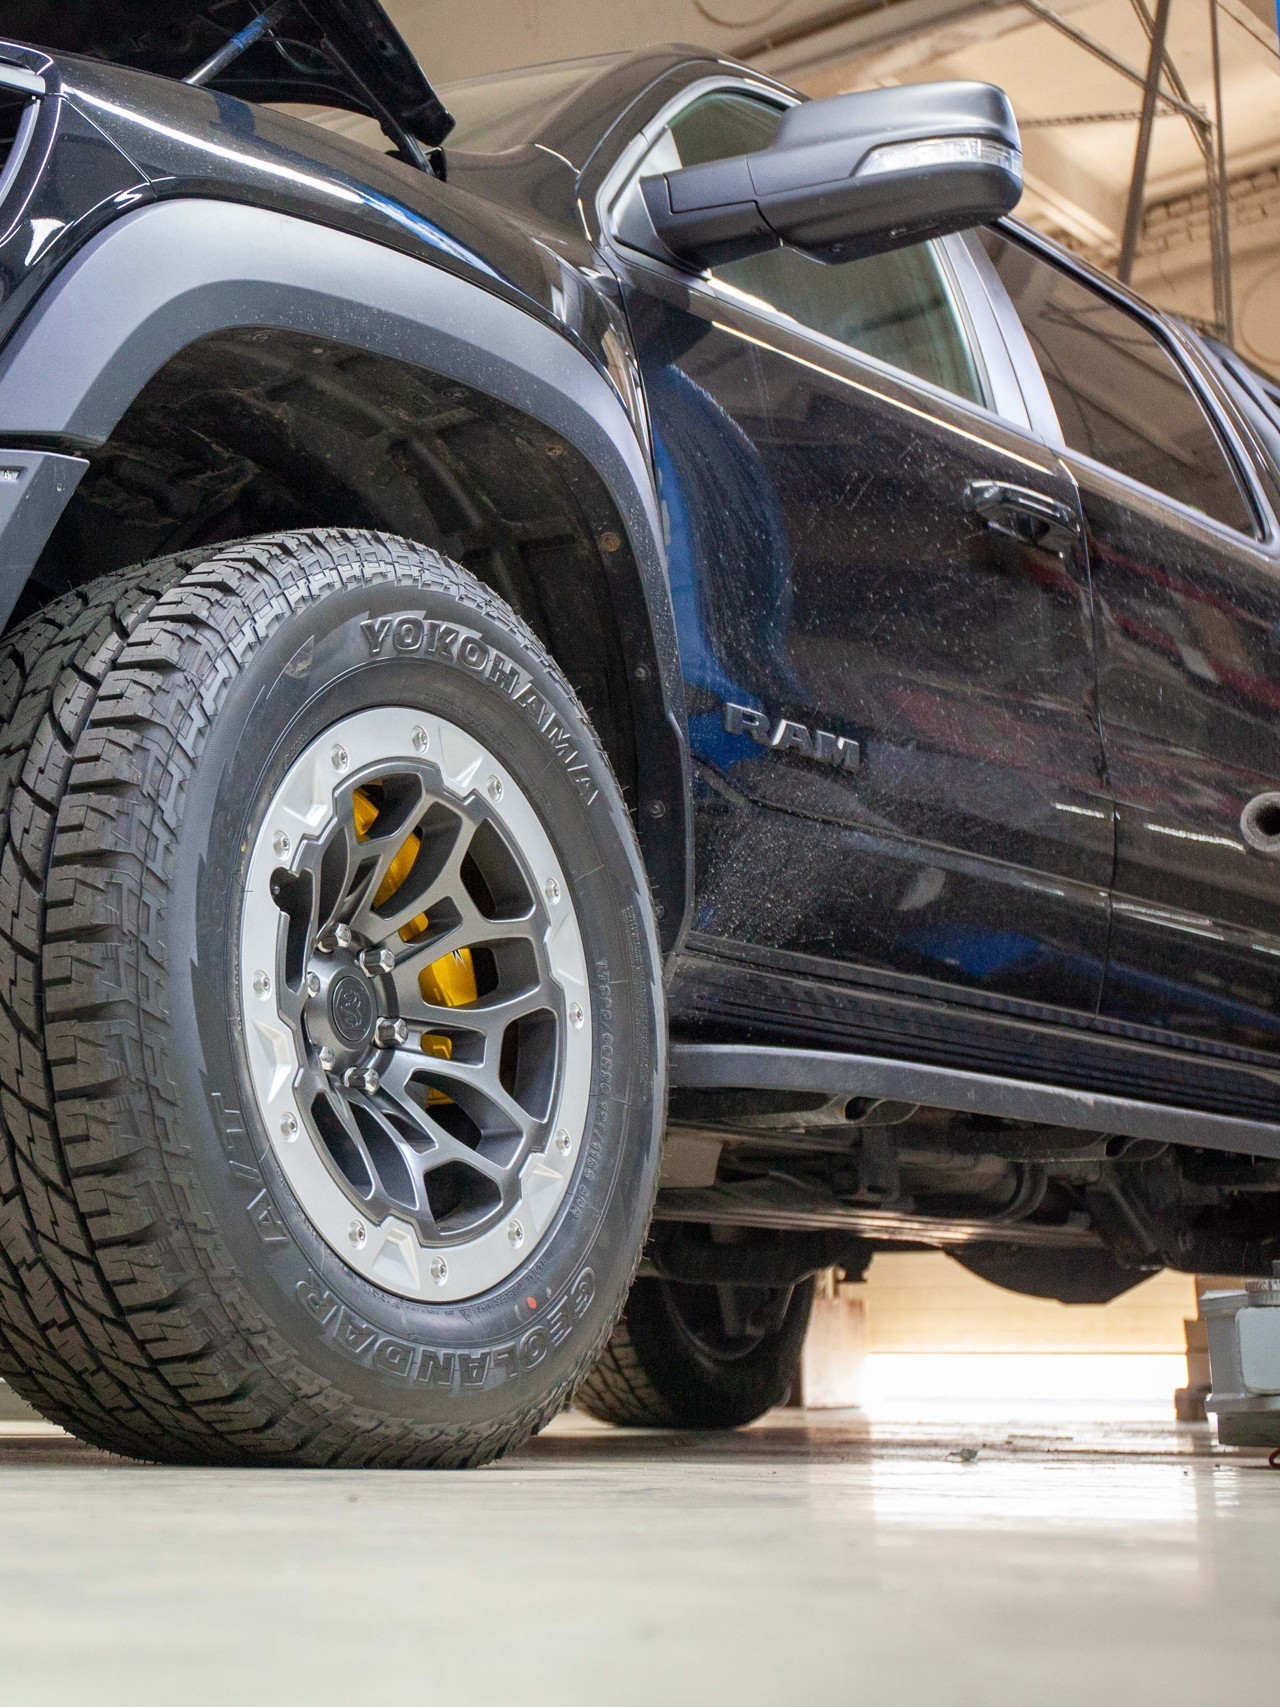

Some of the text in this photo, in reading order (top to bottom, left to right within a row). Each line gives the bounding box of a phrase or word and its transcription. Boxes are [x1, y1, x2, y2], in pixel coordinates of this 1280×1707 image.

[360, 615, 600, 806] YOKOHAMA
[724, 702, 860, 772] RAM
[296, 1266, 596, 1386] GEOLANDAR
